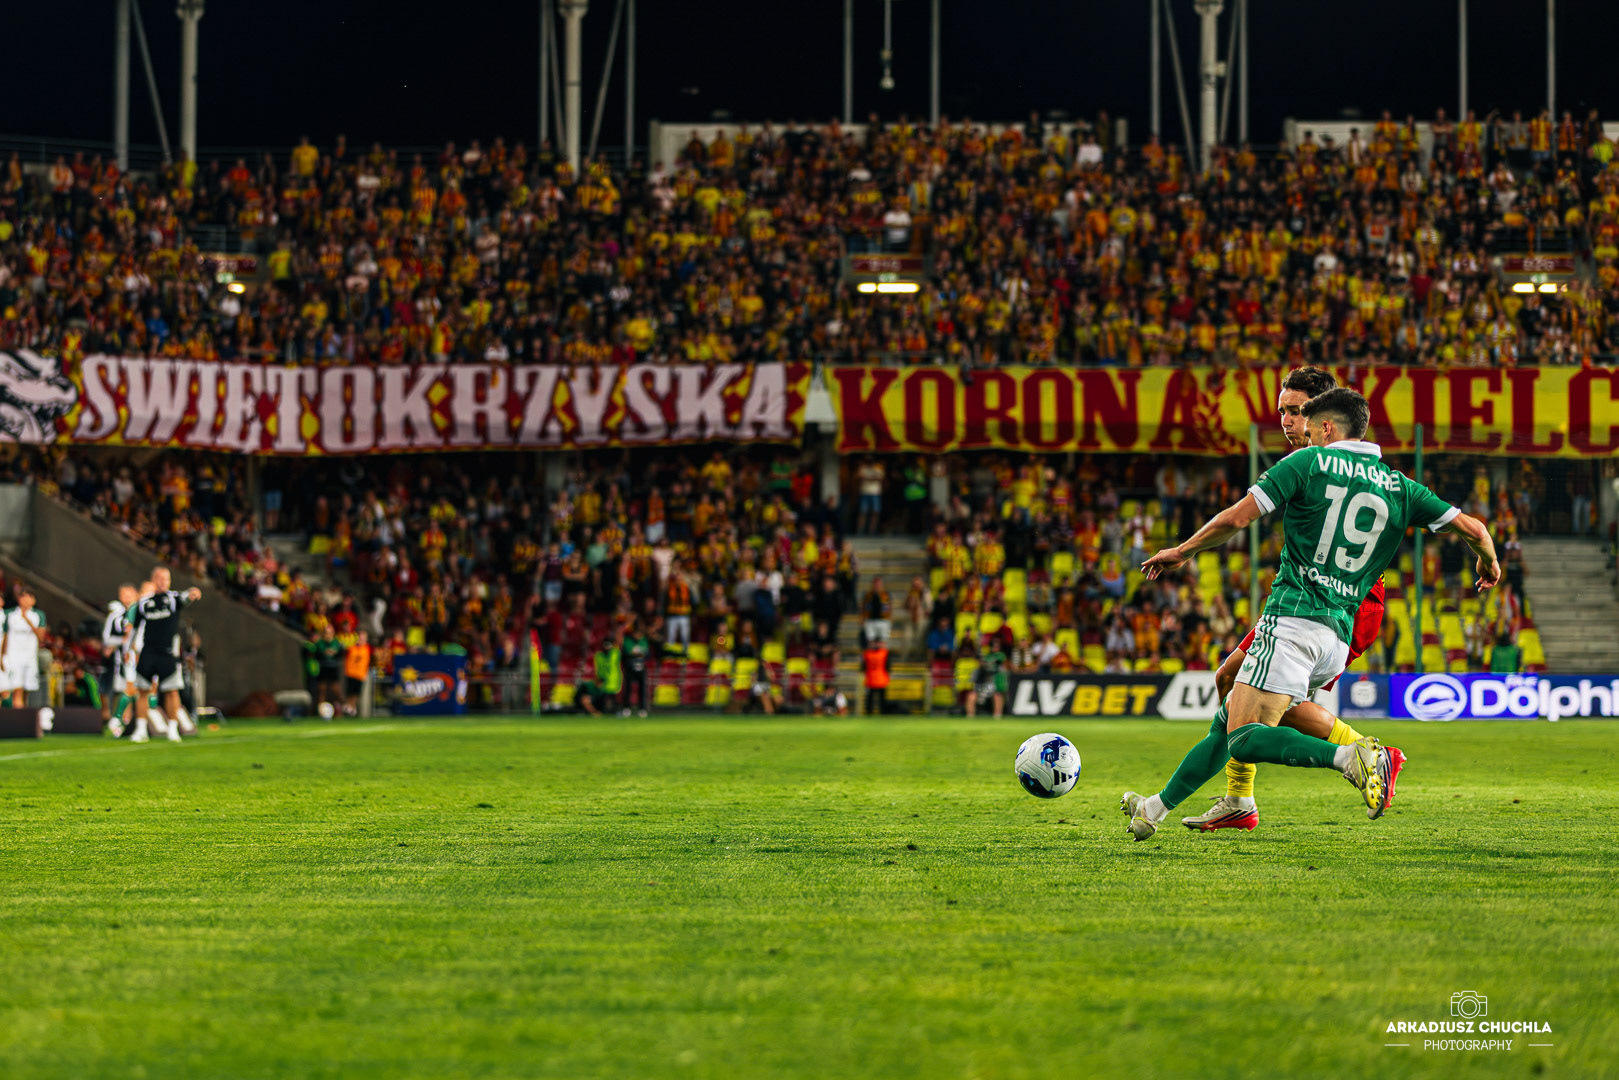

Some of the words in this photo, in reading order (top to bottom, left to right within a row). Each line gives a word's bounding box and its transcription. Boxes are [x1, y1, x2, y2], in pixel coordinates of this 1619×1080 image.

[833, 367, 1209, 452] KORONA
[1317, 453, 1401, 492] VINAGRE
[1313, 484, 1389, 573] 19
